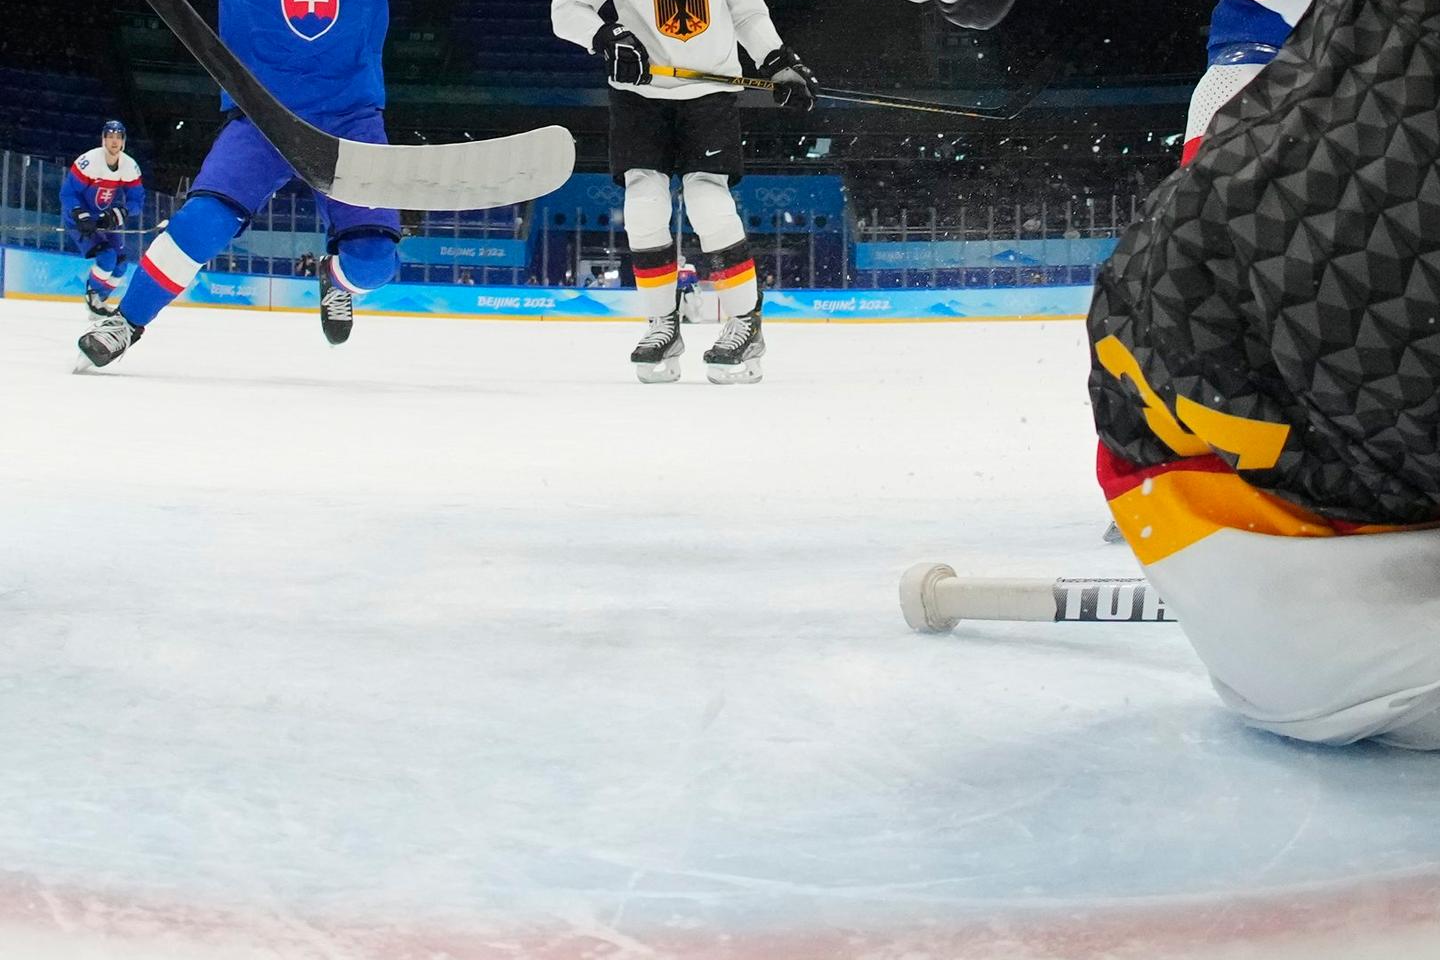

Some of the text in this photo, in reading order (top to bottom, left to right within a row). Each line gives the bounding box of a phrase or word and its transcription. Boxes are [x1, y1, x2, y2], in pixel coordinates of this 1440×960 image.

[731, 77, 775, 89] ALPHA
[440, 245, 476, 258] BEIJING
[477, 295, 556, 309] BEIJING 2022
[813, 298, 891, 313] BEIJING 2022
